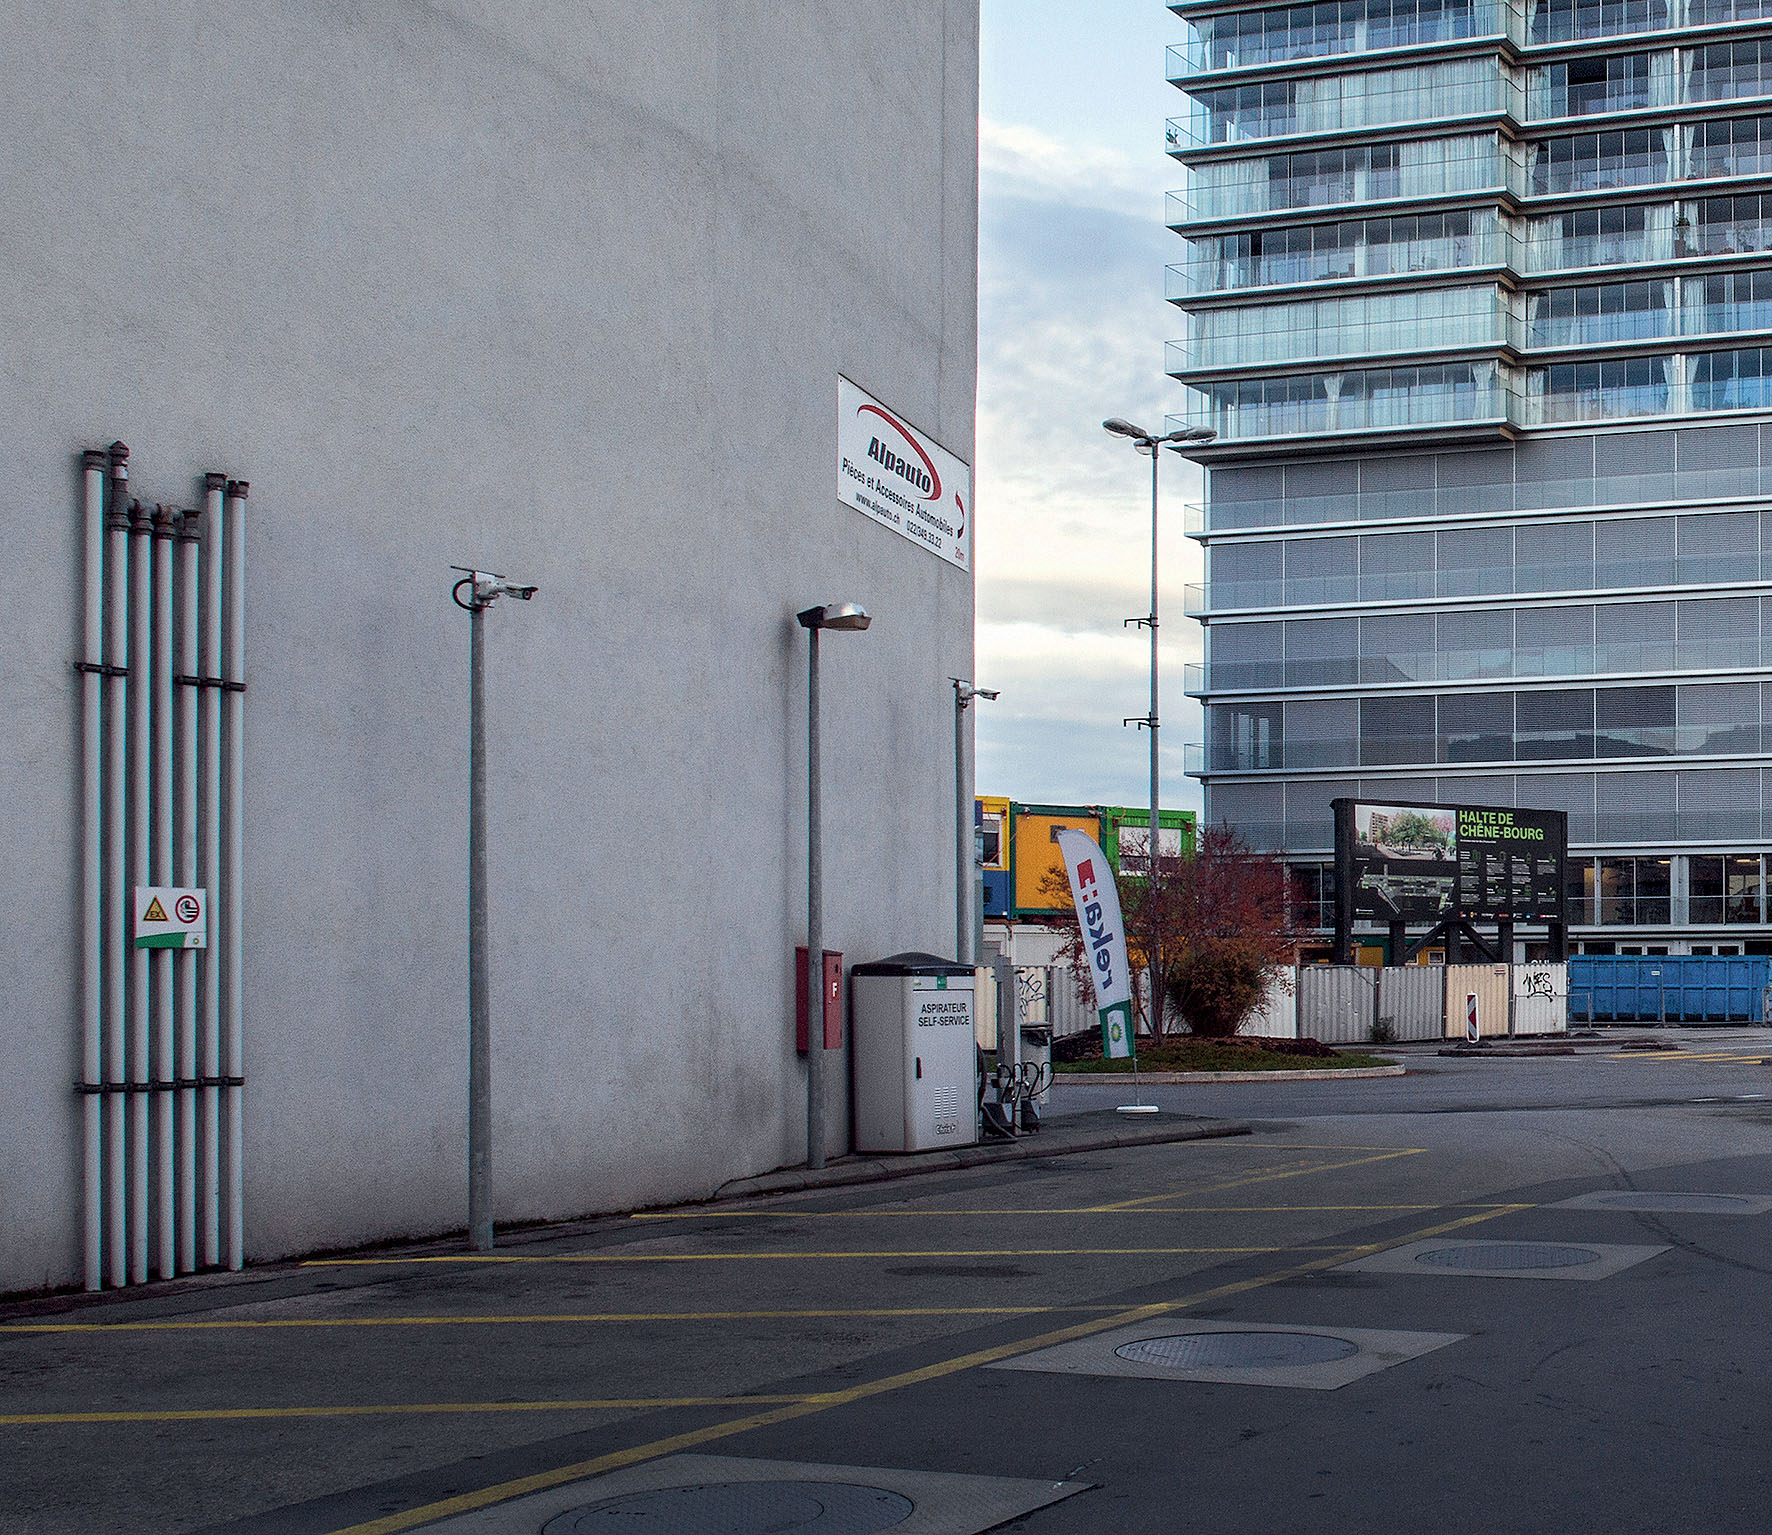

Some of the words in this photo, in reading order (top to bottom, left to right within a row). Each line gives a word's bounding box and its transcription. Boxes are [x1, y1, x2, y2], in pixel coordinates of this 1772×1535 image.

[867, 436, 932, 493] Alpauto
[842, 457, 866, 485] Pièces
[866, 477, 875, 490] et
[876, 479, 914, 514] Accessoires
[915, 504, 953, 537] Automobiles
[855, 492, 901, 525] www.alpauto.ch
[1459, 810, 1496, 825] HALTE
[1498, 812, 1514, 825] DE
[1459, 823, 1544, 841] CHÊNE-BOURG
[832, 982, 838, 997] F
[921, 1002, 967, 1014] ASPIRATEUR
[918, 1014, 970, 1027] SELF-SERVICE
